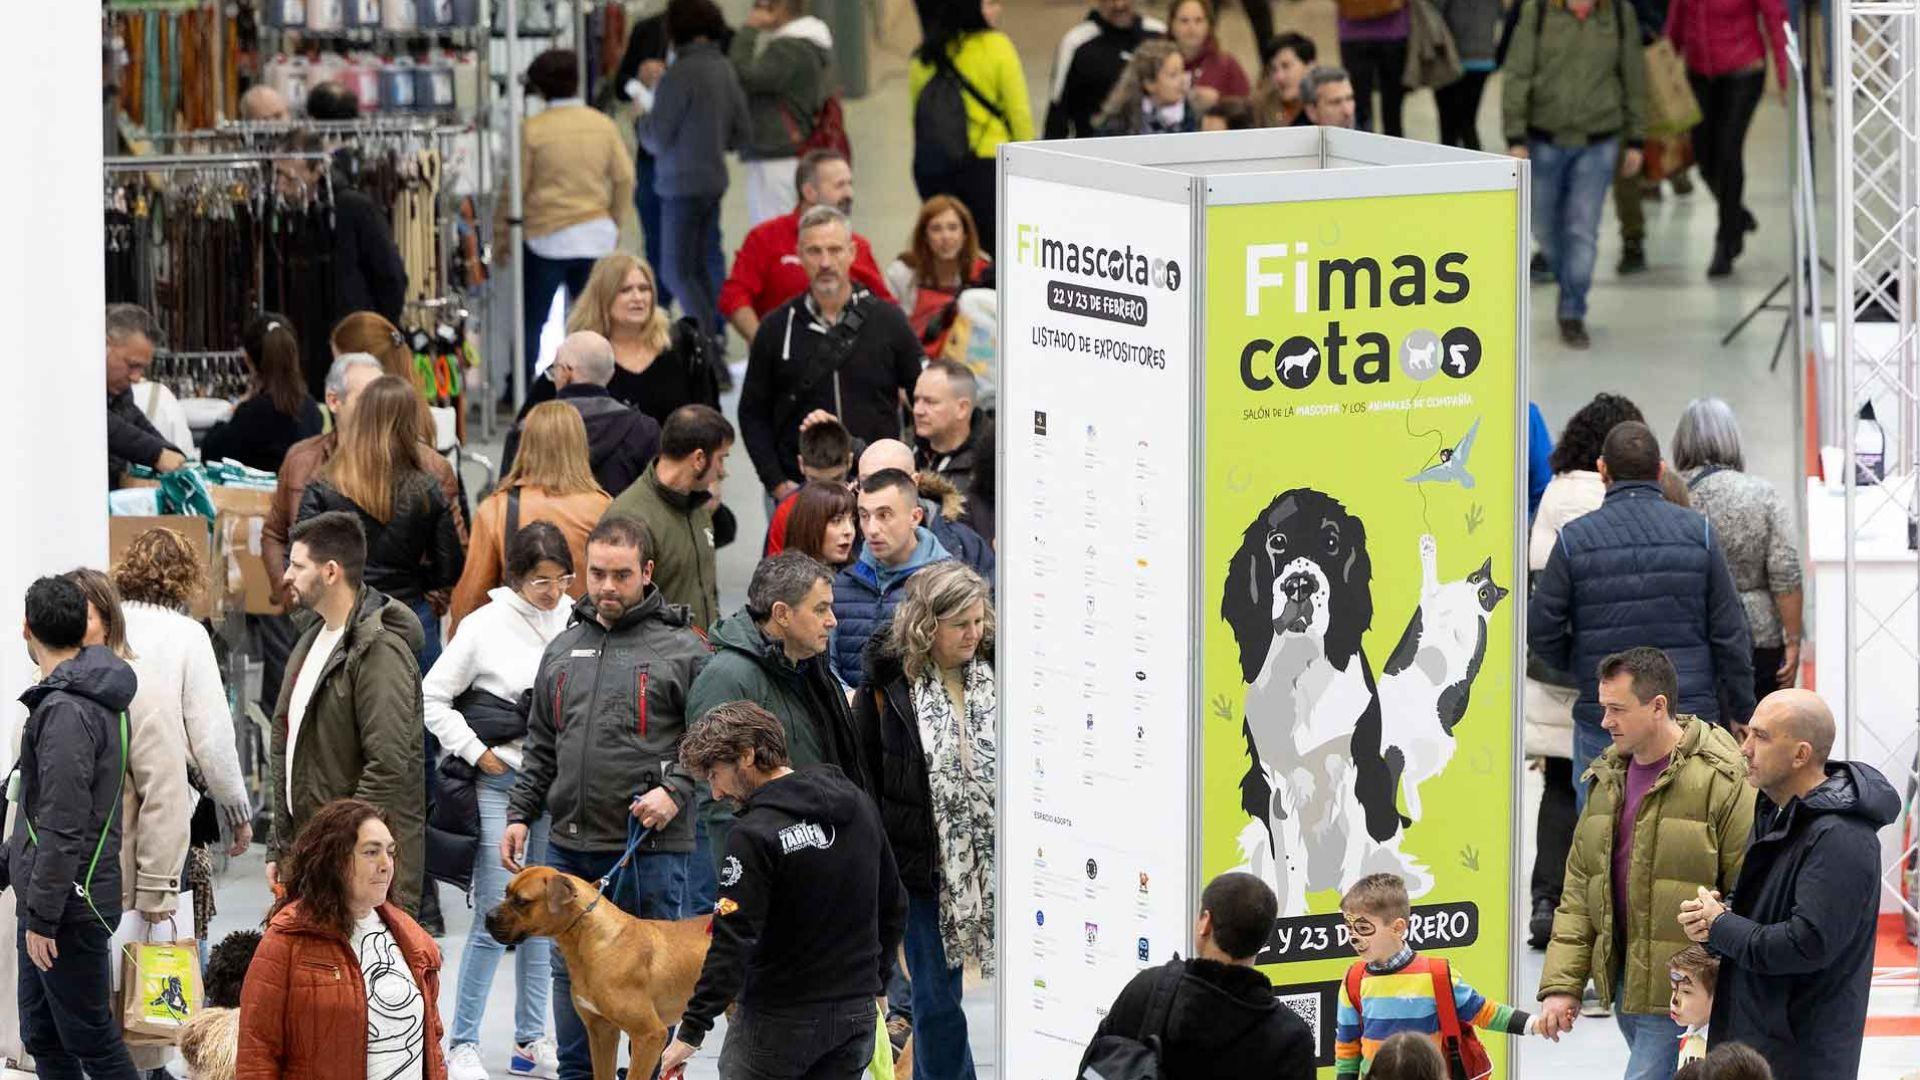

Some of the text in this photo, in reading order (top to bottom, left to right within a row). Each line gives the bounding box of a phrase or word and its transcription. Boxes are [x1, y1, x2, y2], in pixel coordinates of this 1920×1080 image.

[1245, 241, 1470, 316] Fimas
[1053, 288, 1145, 322] 22 Y 23 DE FEBRERO
[1032, 326, 1166, 370] LISTADO DE EXPOSITORES
[1243, 405, 1270, 420] SALÓN
[1272, 408, 1282, 418] DE
[1284, 405, 1294, 417] LA
[1296, 403, 1341, 417] MASCOTA
[1342, 403, 1348, 414] Y
[1350, 401, 1366, 414] LOS
[1278, 927, 1293, 954] Y
[1300, 926, 1329, 951] 23
[1335, 924, 1350, 947] D
